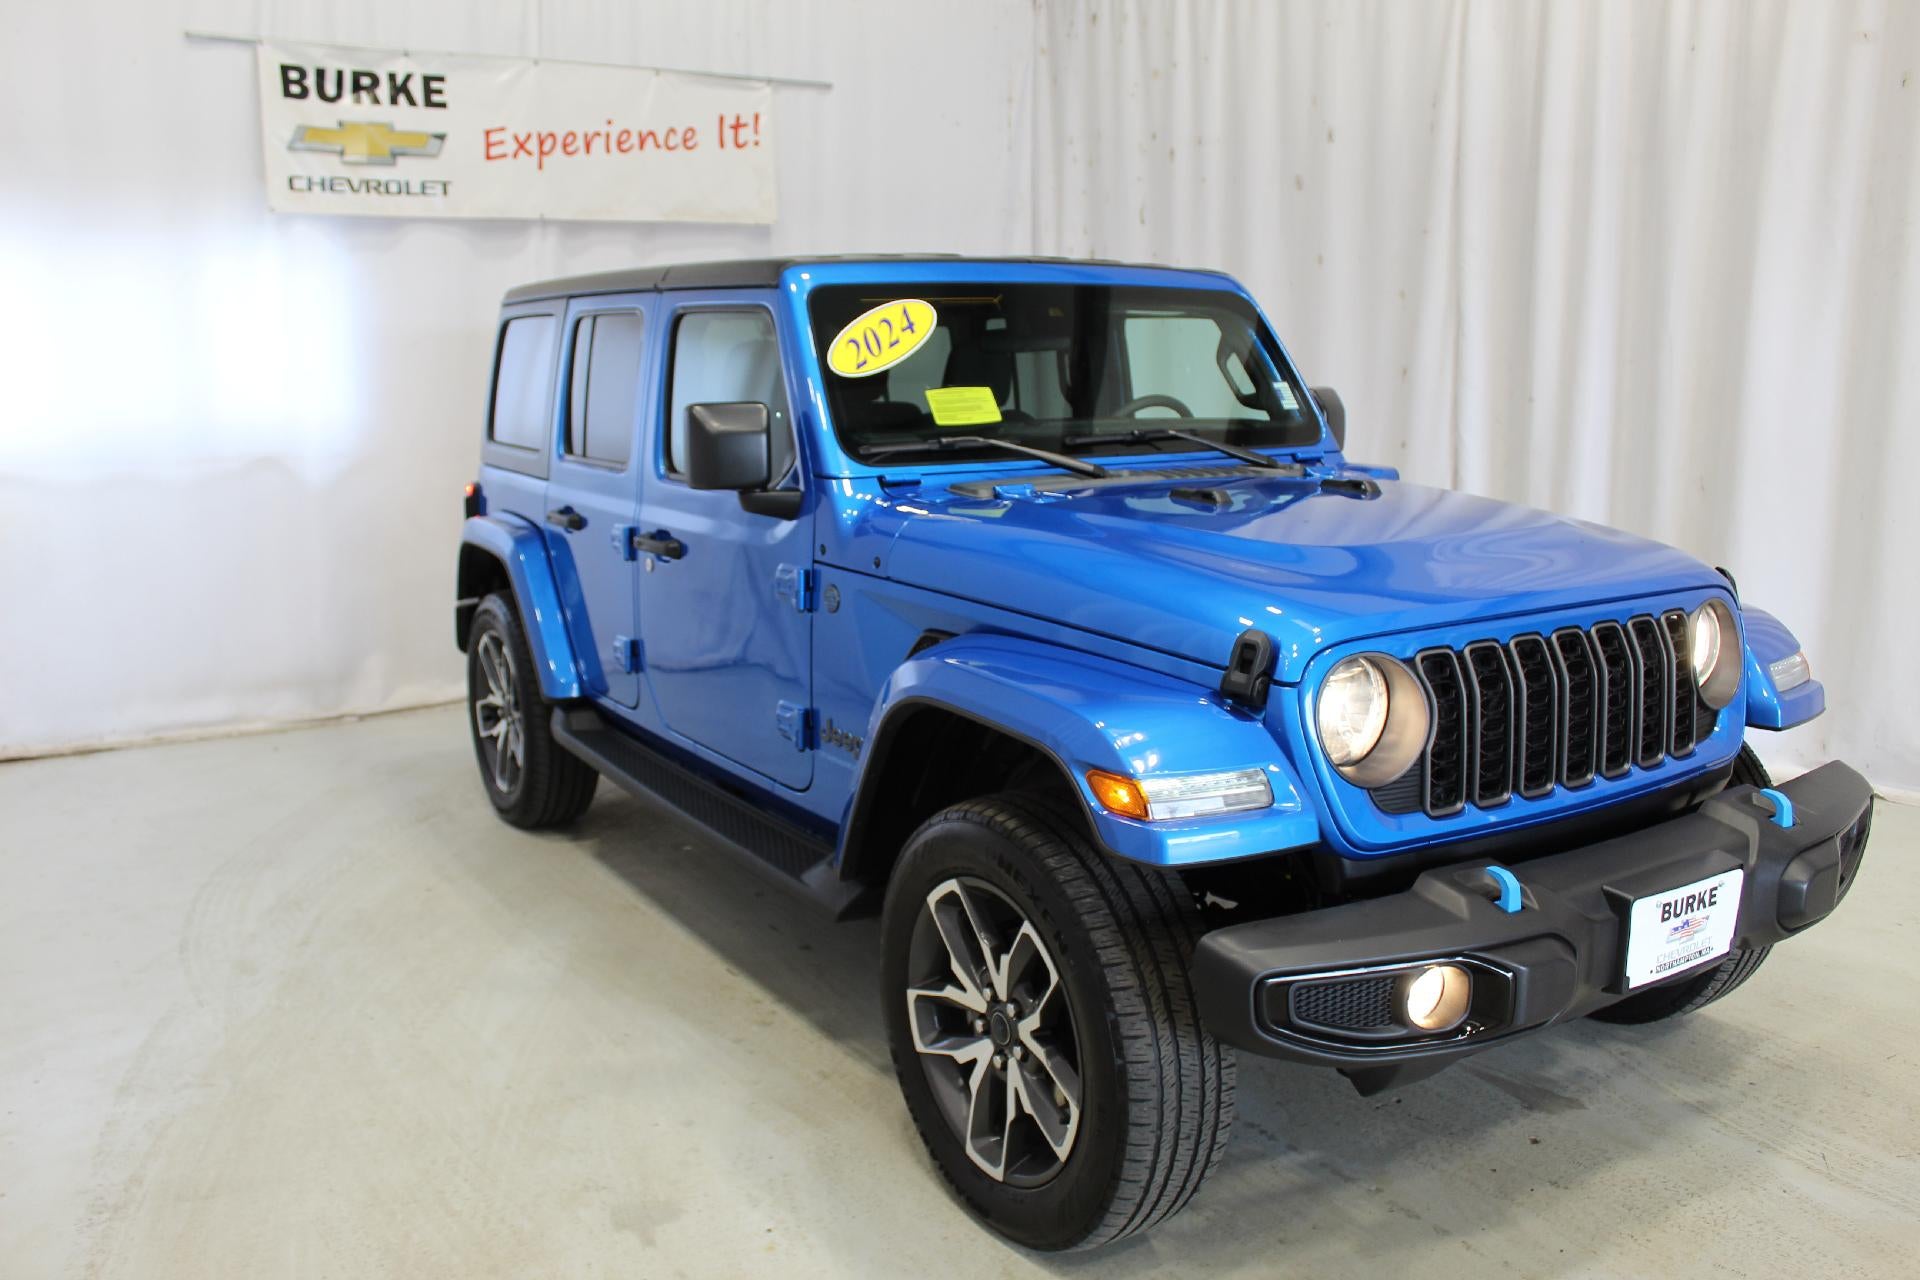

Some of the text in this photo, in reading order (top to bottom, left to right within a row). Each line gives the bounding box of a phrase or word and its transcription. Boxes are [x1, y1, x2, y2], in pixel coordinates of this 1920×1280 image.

[280, 64, 447, 108] BURKE
[483, 113, 760, 170] Experience It!
[288, 175, 451, 196] CHEVROLET
[847, 304, 914, 369] 2024
[821, 718, 863, 759] Jeep
[1661, 886, 1718, 923] BURKE
[1656, 937, 1712, 963] CHEVROLET
